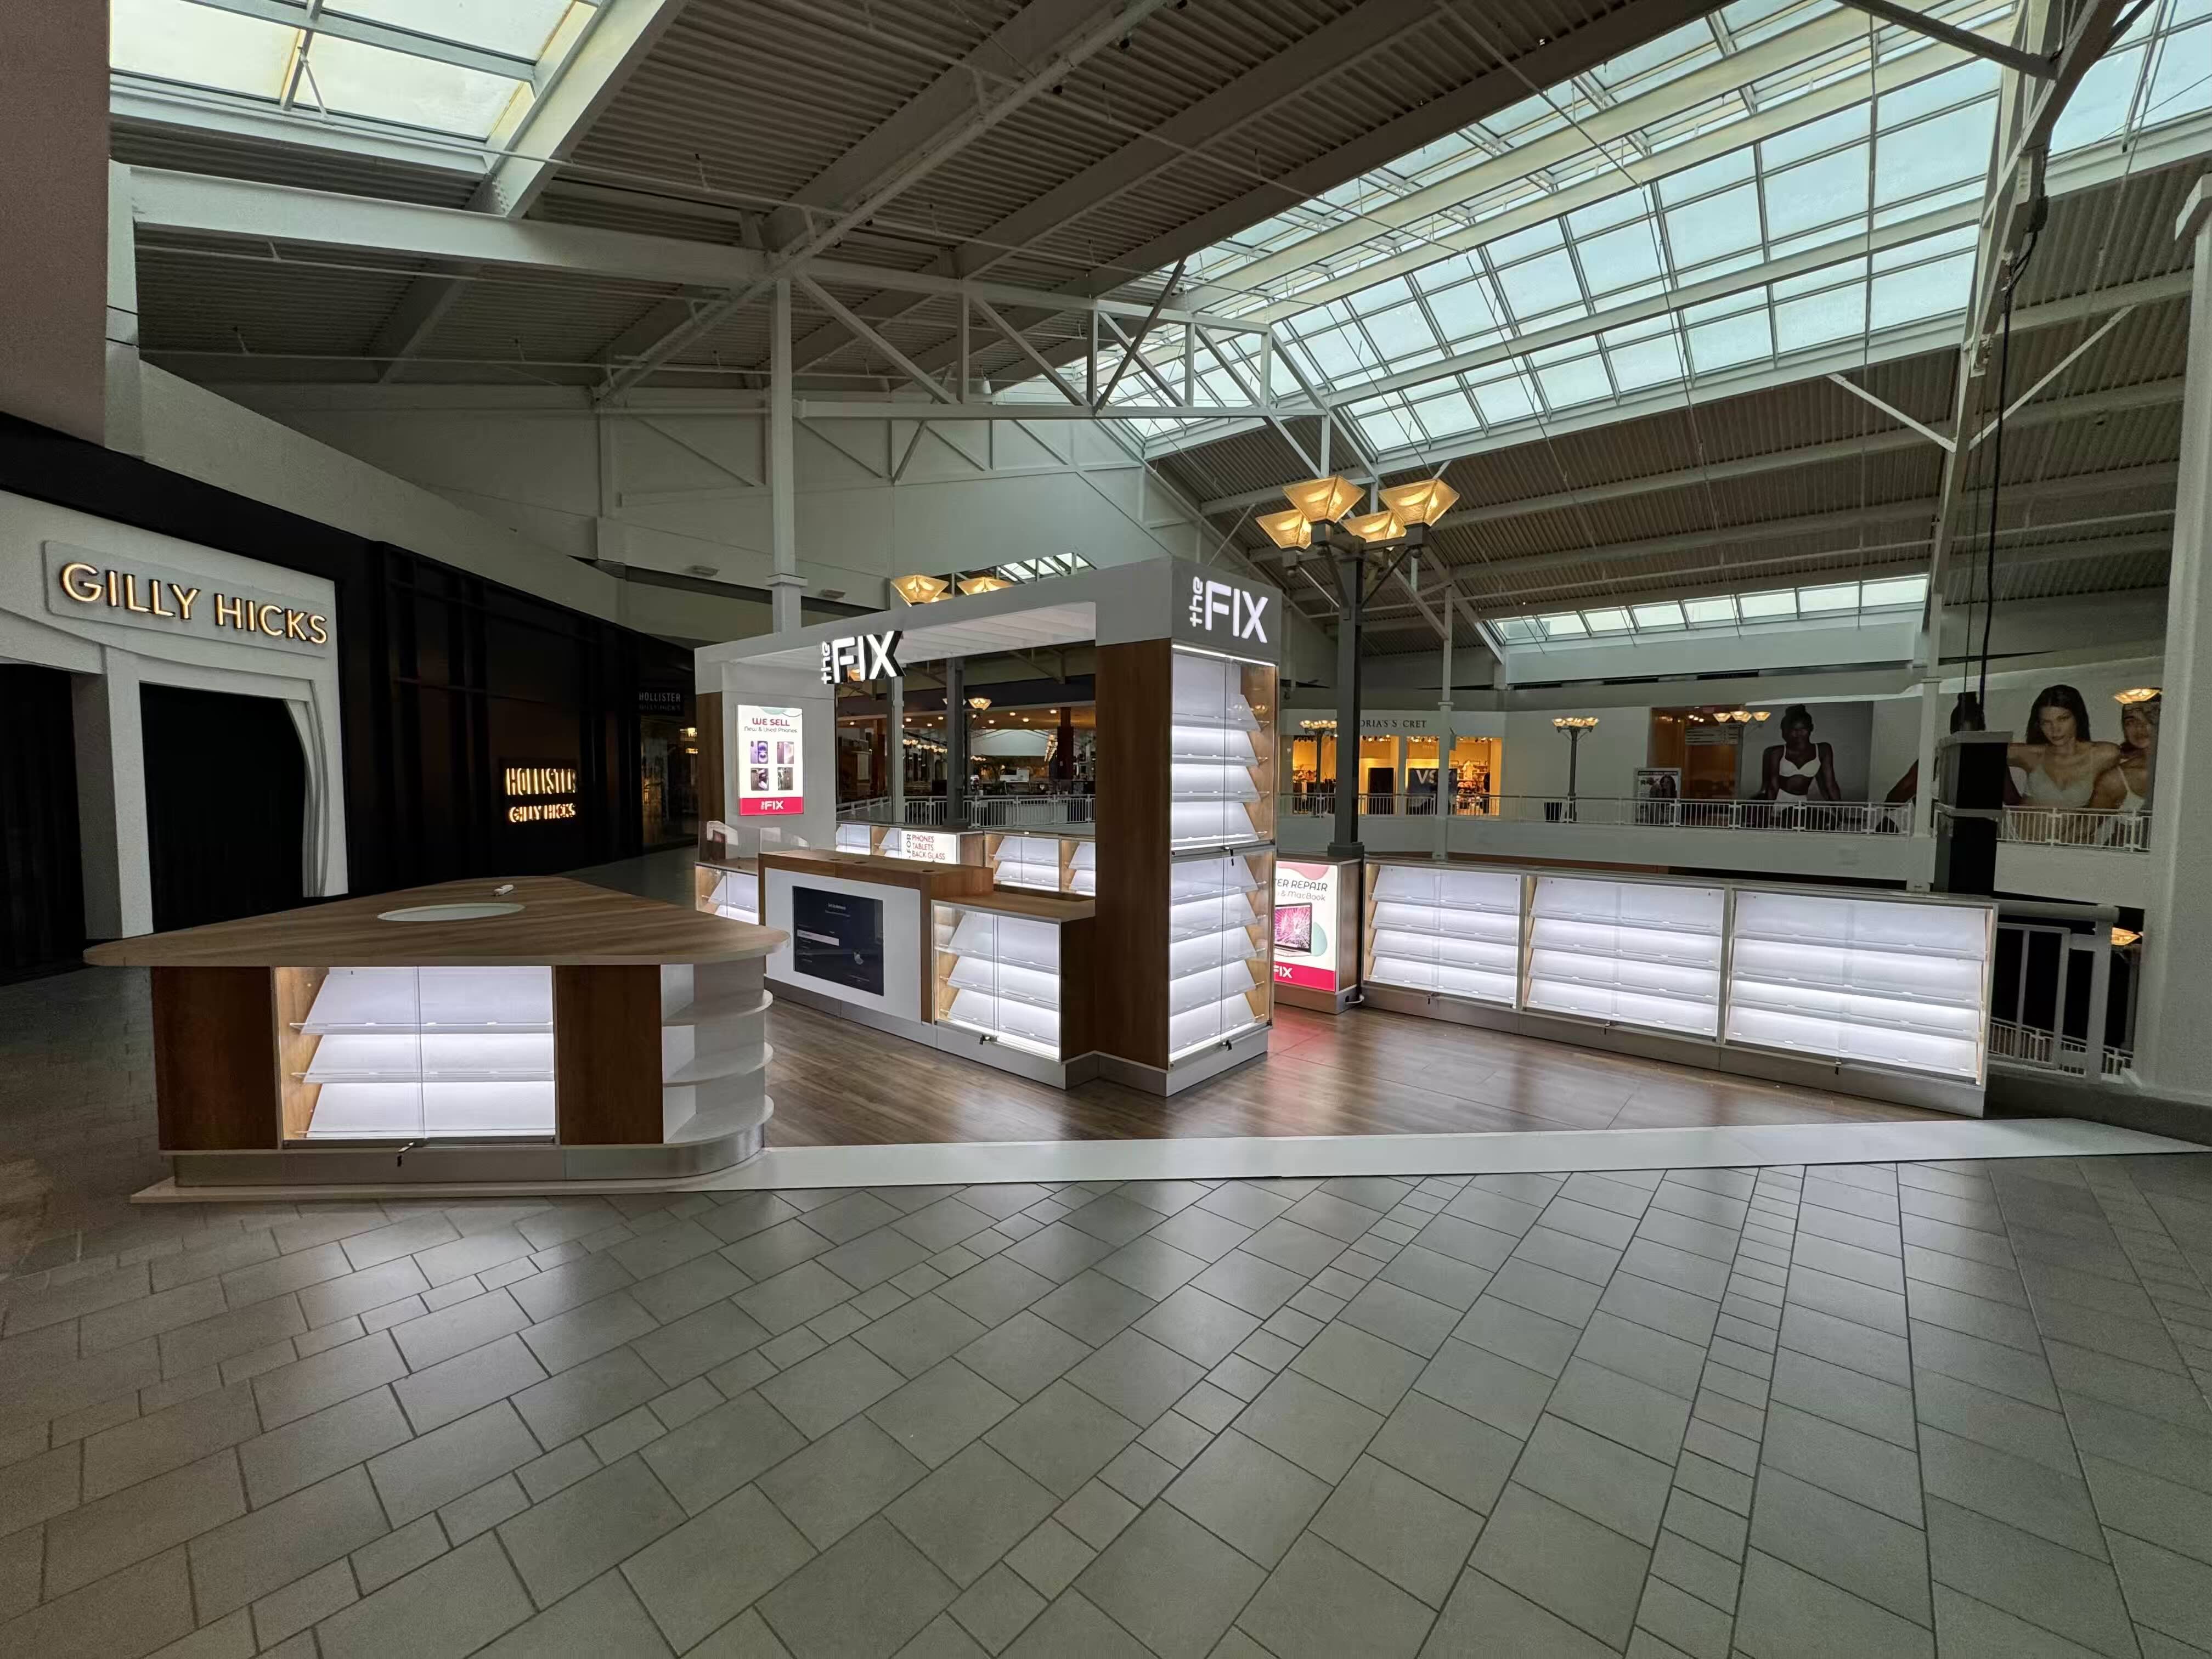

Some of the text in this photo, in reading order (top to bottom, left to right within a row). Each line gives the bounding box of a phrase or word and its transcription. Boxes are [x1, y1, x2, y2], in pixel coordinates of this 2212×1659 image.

[60, 562, 329, 645] GILLY HICKS
[1189, 576, 1269, 644] the FIX
[821, 630, 901, 684] the FIX
[639, 692, 681, 702] HOLLISTER
[765, 800, 784, 810] FIX
[912, 834, 934, 843] PHONES
[912, 842, 934, 851] TABLETS
[928, 852, 945, 860] GLASS
[1291, 880, 1328, 892] REPAIR
[1288, 890, 1326, 901] MacBook
